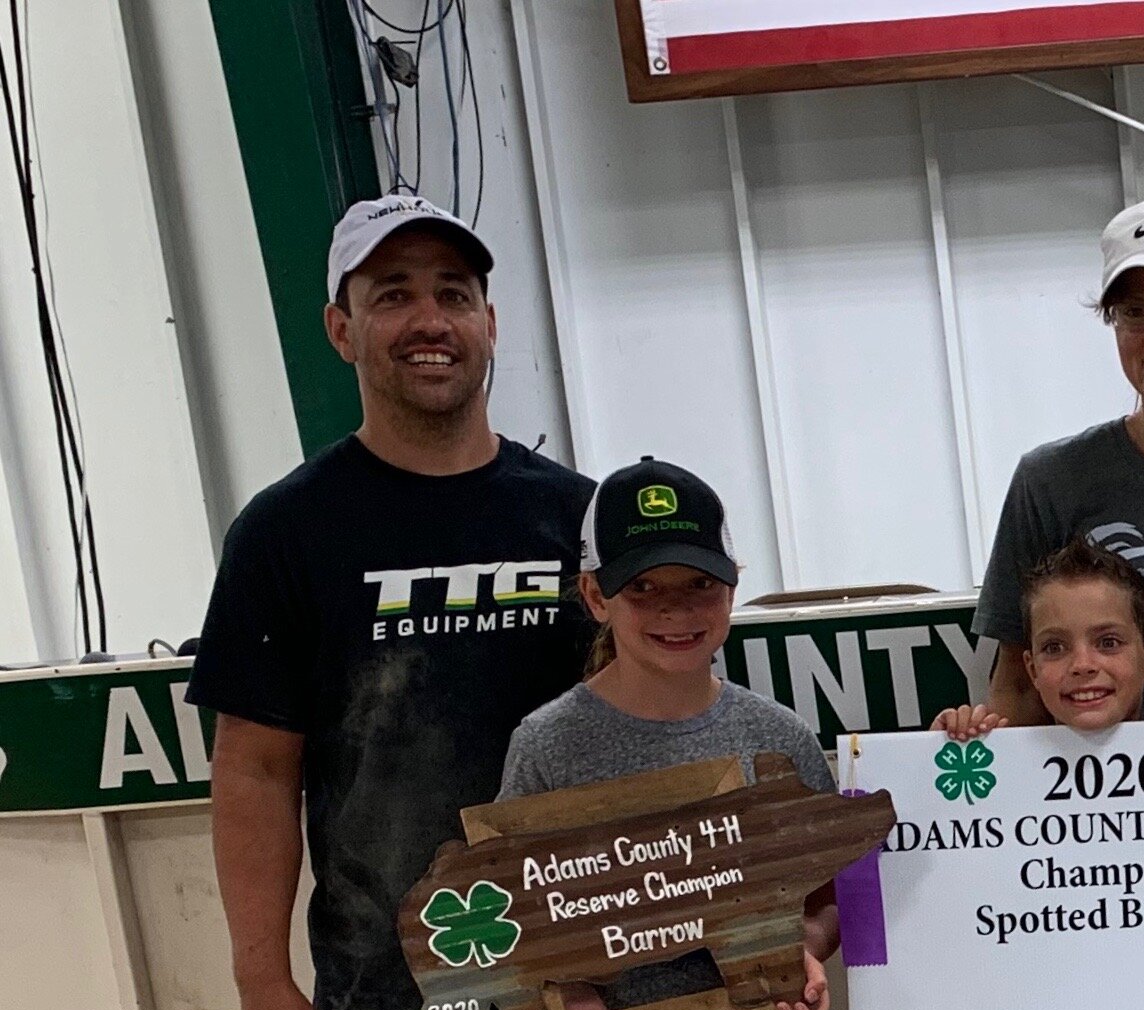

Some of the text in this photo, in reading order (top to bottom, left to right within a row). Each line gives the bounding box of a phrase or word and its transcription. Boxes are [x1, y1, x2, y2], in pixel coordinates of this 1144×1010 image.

[625, 520, 701, 537] JOHN DEERE
[364, 560, 562, 616] TTG
[373, 608, 560, 641] EQUIPMENT
[523, 815, 743, 890] Adams County 4-H
[882, 817, 1004, 853] DAMS
[546, 865, 743, 922] Reserve Champion
[601, 918, 704, 958] Barrow
[976, 898, 1109, 944] Spotted
